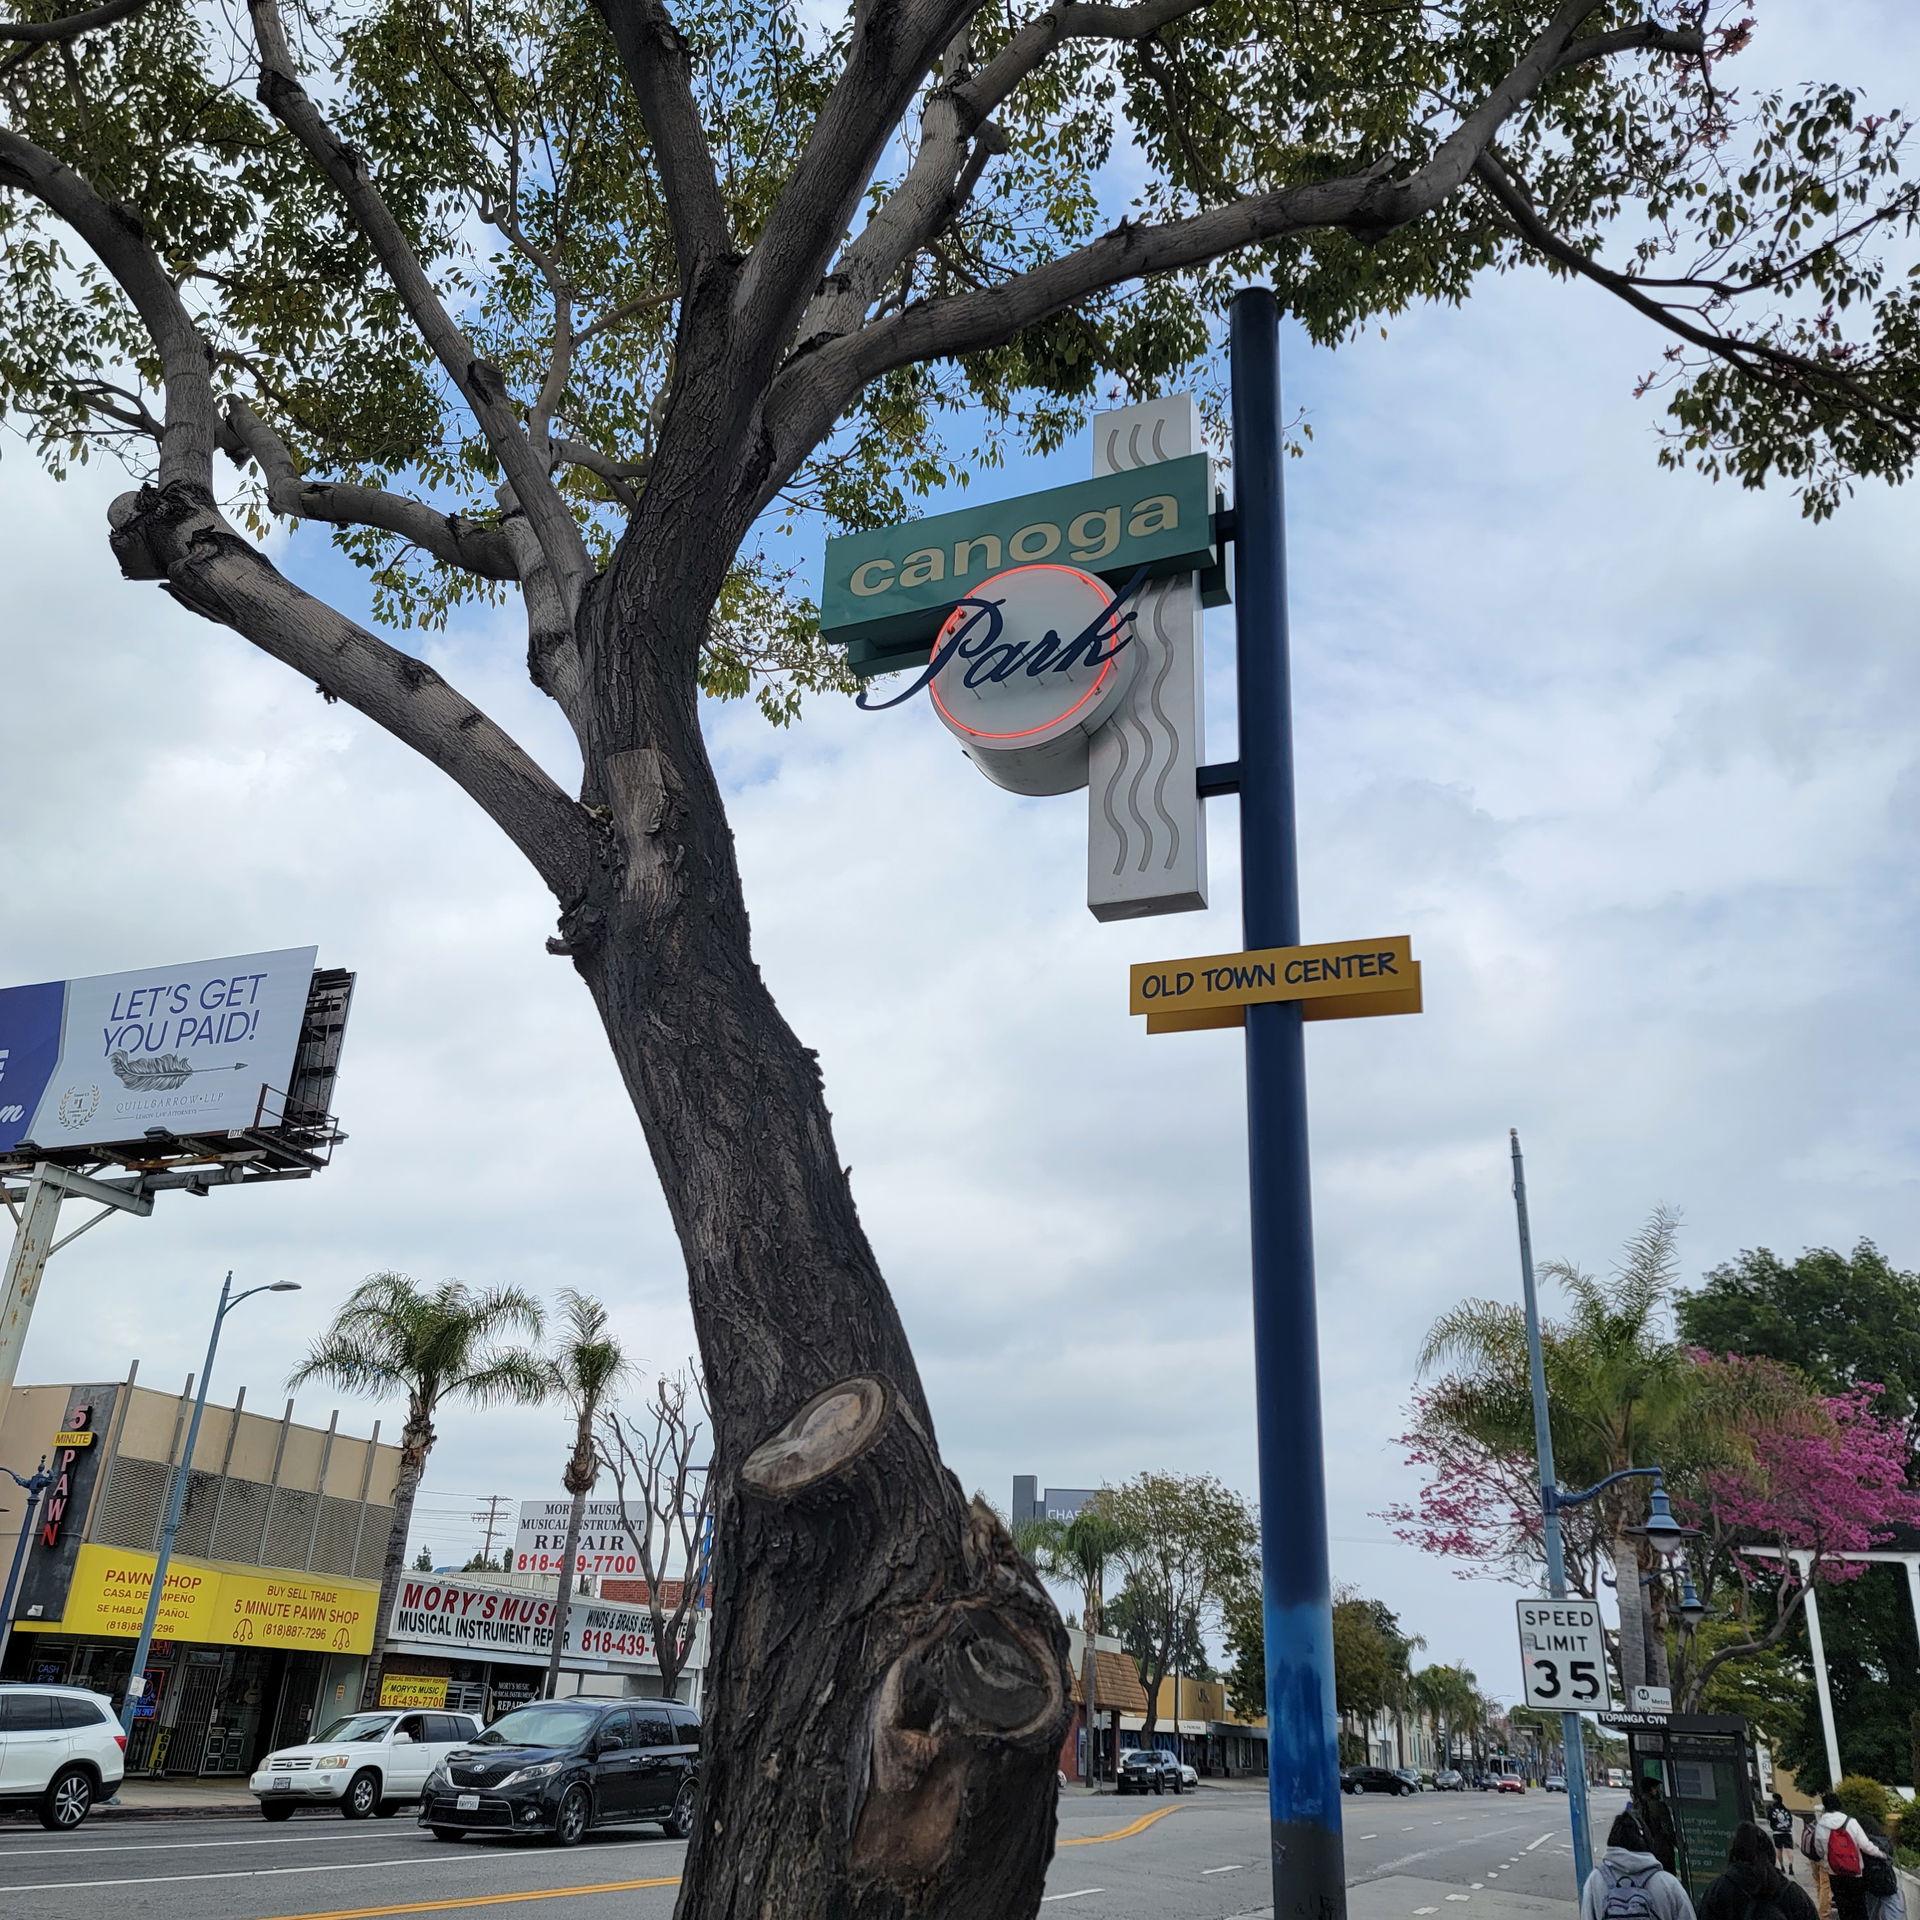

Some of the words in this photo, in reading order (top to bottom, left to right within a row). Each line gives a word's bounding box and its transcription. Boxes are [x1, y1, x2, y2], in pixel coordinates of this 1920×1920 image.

[850, 494, 1179, 597] canoga
[855, 566, 1153, 711] Park
[1142, 972, 1194, 999] OLD
[1202, 963, 1275, 992] TOWN
[1284, 952, 1399, 983] CENTER
[110, 983, 191, 1022] LET'S
[200, 973, 268, 1010] GET
[103, 1020, 169, 1057] YOU
[175, 1009, 260, 1049] PAID!
[68, 1405, 87, 1429] 5
[54, 1433, 90, 1444] MINUTE
[520, 1518, 569, 1530] MUSICAL
[517, 1553, 637, 1573] 818-49-7700
[105, 1569, 154, 1586] PAWN
[103, 1588, 132, 1599] CASA
[134, 1590, 149, 1600] DE
[267, 1585, 285, 1597] BUY
[287, 1587, 308, 1600] SELL
[310, 1590, 338, 1603] TRADE
[402, 1583, 498, 1619] MORY'S
[96, 1604, 110, 1613] SE
[112, 1605, 144, 1615] HABLA
[157, 1607, 190, 1619] PAÑOL
[234, 1599, 242, 1613] 5
[244, 1600, 291, 1618] MINUTE
[293, 1604, 327, 1622] PAWN
[328, 1609, 359, 1625] SHOP
[1524, 1610, 1594, 1627] SPEED
[397, 1610, 452, 1636] MUSICAL
[454, 1617, 531, 1645] INSTRUMENT
[532, 1627, 570, 1650] REPR
[585, 1609, 610, 1629] WINDS
[609, 1612, 616, 1629] &
[615, 1613, 638, 1633] BRASS
[262, 1623, 327, 1640] (818)887-7296
[1534, 1634, 1588, 1652] LIMIT
[38, 1664, 60, 1674] CASH
[1533, 1659, 1600, 1700] 35
[389, 1684, 417, 1694] MORY'S
[417, 1686, 440, 1695] MUSIC
[381, 1694, 444, 1708] 818-439-7700
[1651, 1698, 1670, 1706] Metro
[1600, 1713, 1645, 1724] TOPANGA
[1646, 1715, 1668, 1725] CYN
